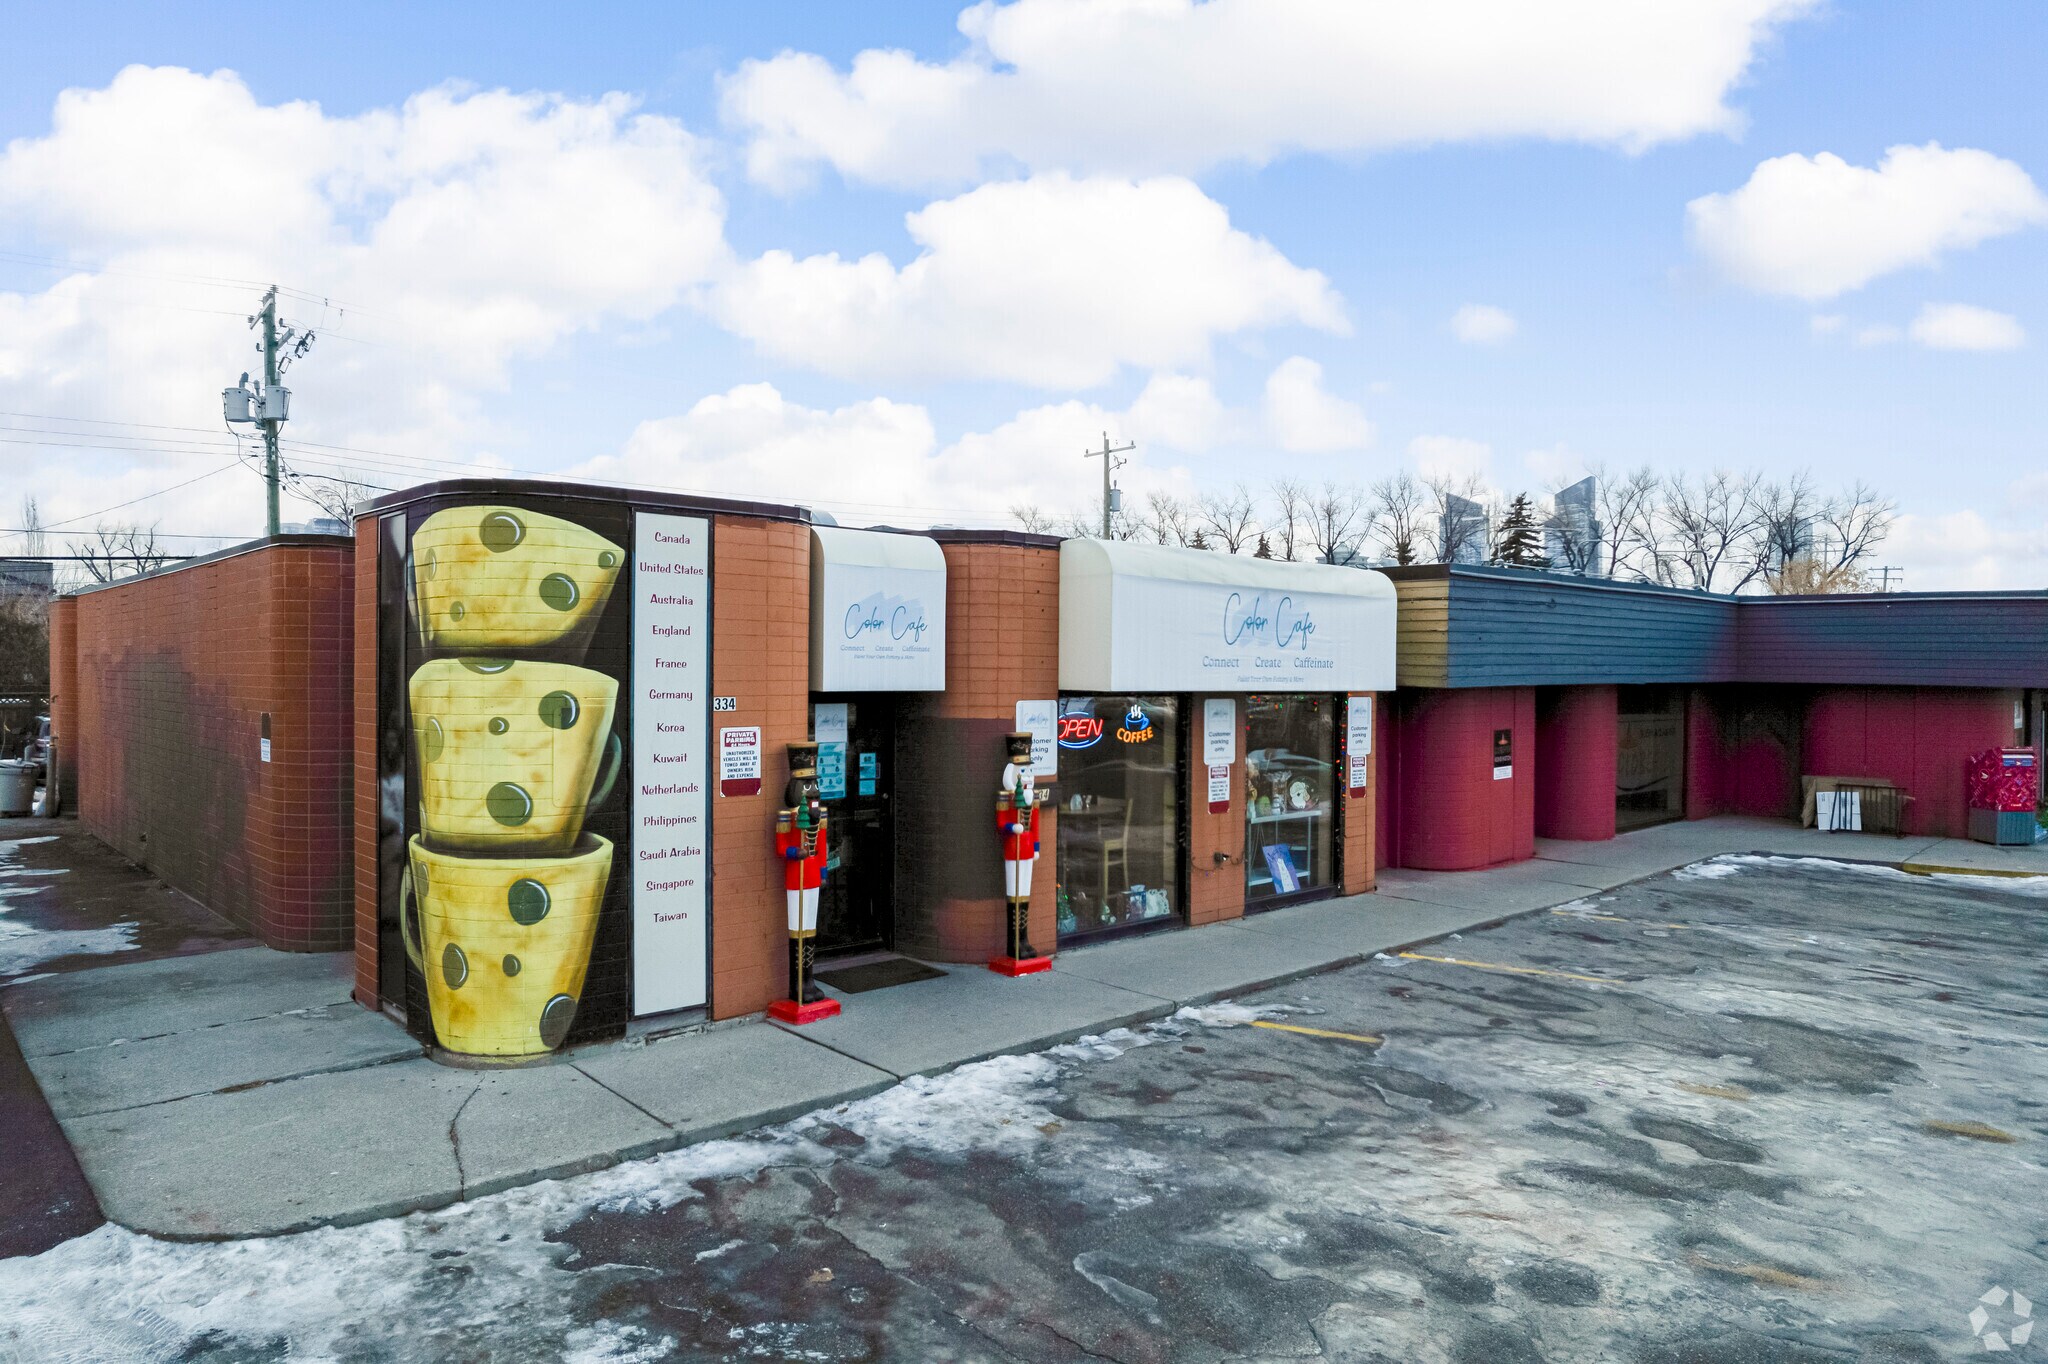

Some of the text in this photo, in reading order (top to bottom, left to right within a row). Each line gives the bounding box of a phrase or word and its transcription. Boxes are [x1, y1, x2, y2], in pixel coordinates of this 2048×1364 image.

[654, 532, 690, 545] Canada
[639, 561, 704, 576] United States
[650, 593, 694, 606] Australia
[845, 603, 928, 642] Color Cafe
[1223, 592, 1316, 650] Color Cafe
[652, 624, 691, 638] England
[655, 657, 687, 669] France
[1202, 656, 1334, 669] Connect Create Caffeinate
[649, 689, 693, 702] Germany
[714, 698, 735, 710] 334
[656, 722, 685, 733] Korea
[1058, 718, 1104, 739] OPEN
[1116, 726, 1154, 744] COFFEE
[653, 753, 687, 764] Kuwait
[641, 783, 699, 796] Netherlands
[643, 815, 697, 828] Philippines
[639, 846, 701, 861] Saudi Arabia
[646, 878, 694, 892] Singapore
[653, 912, 688, 923] Taiwan
